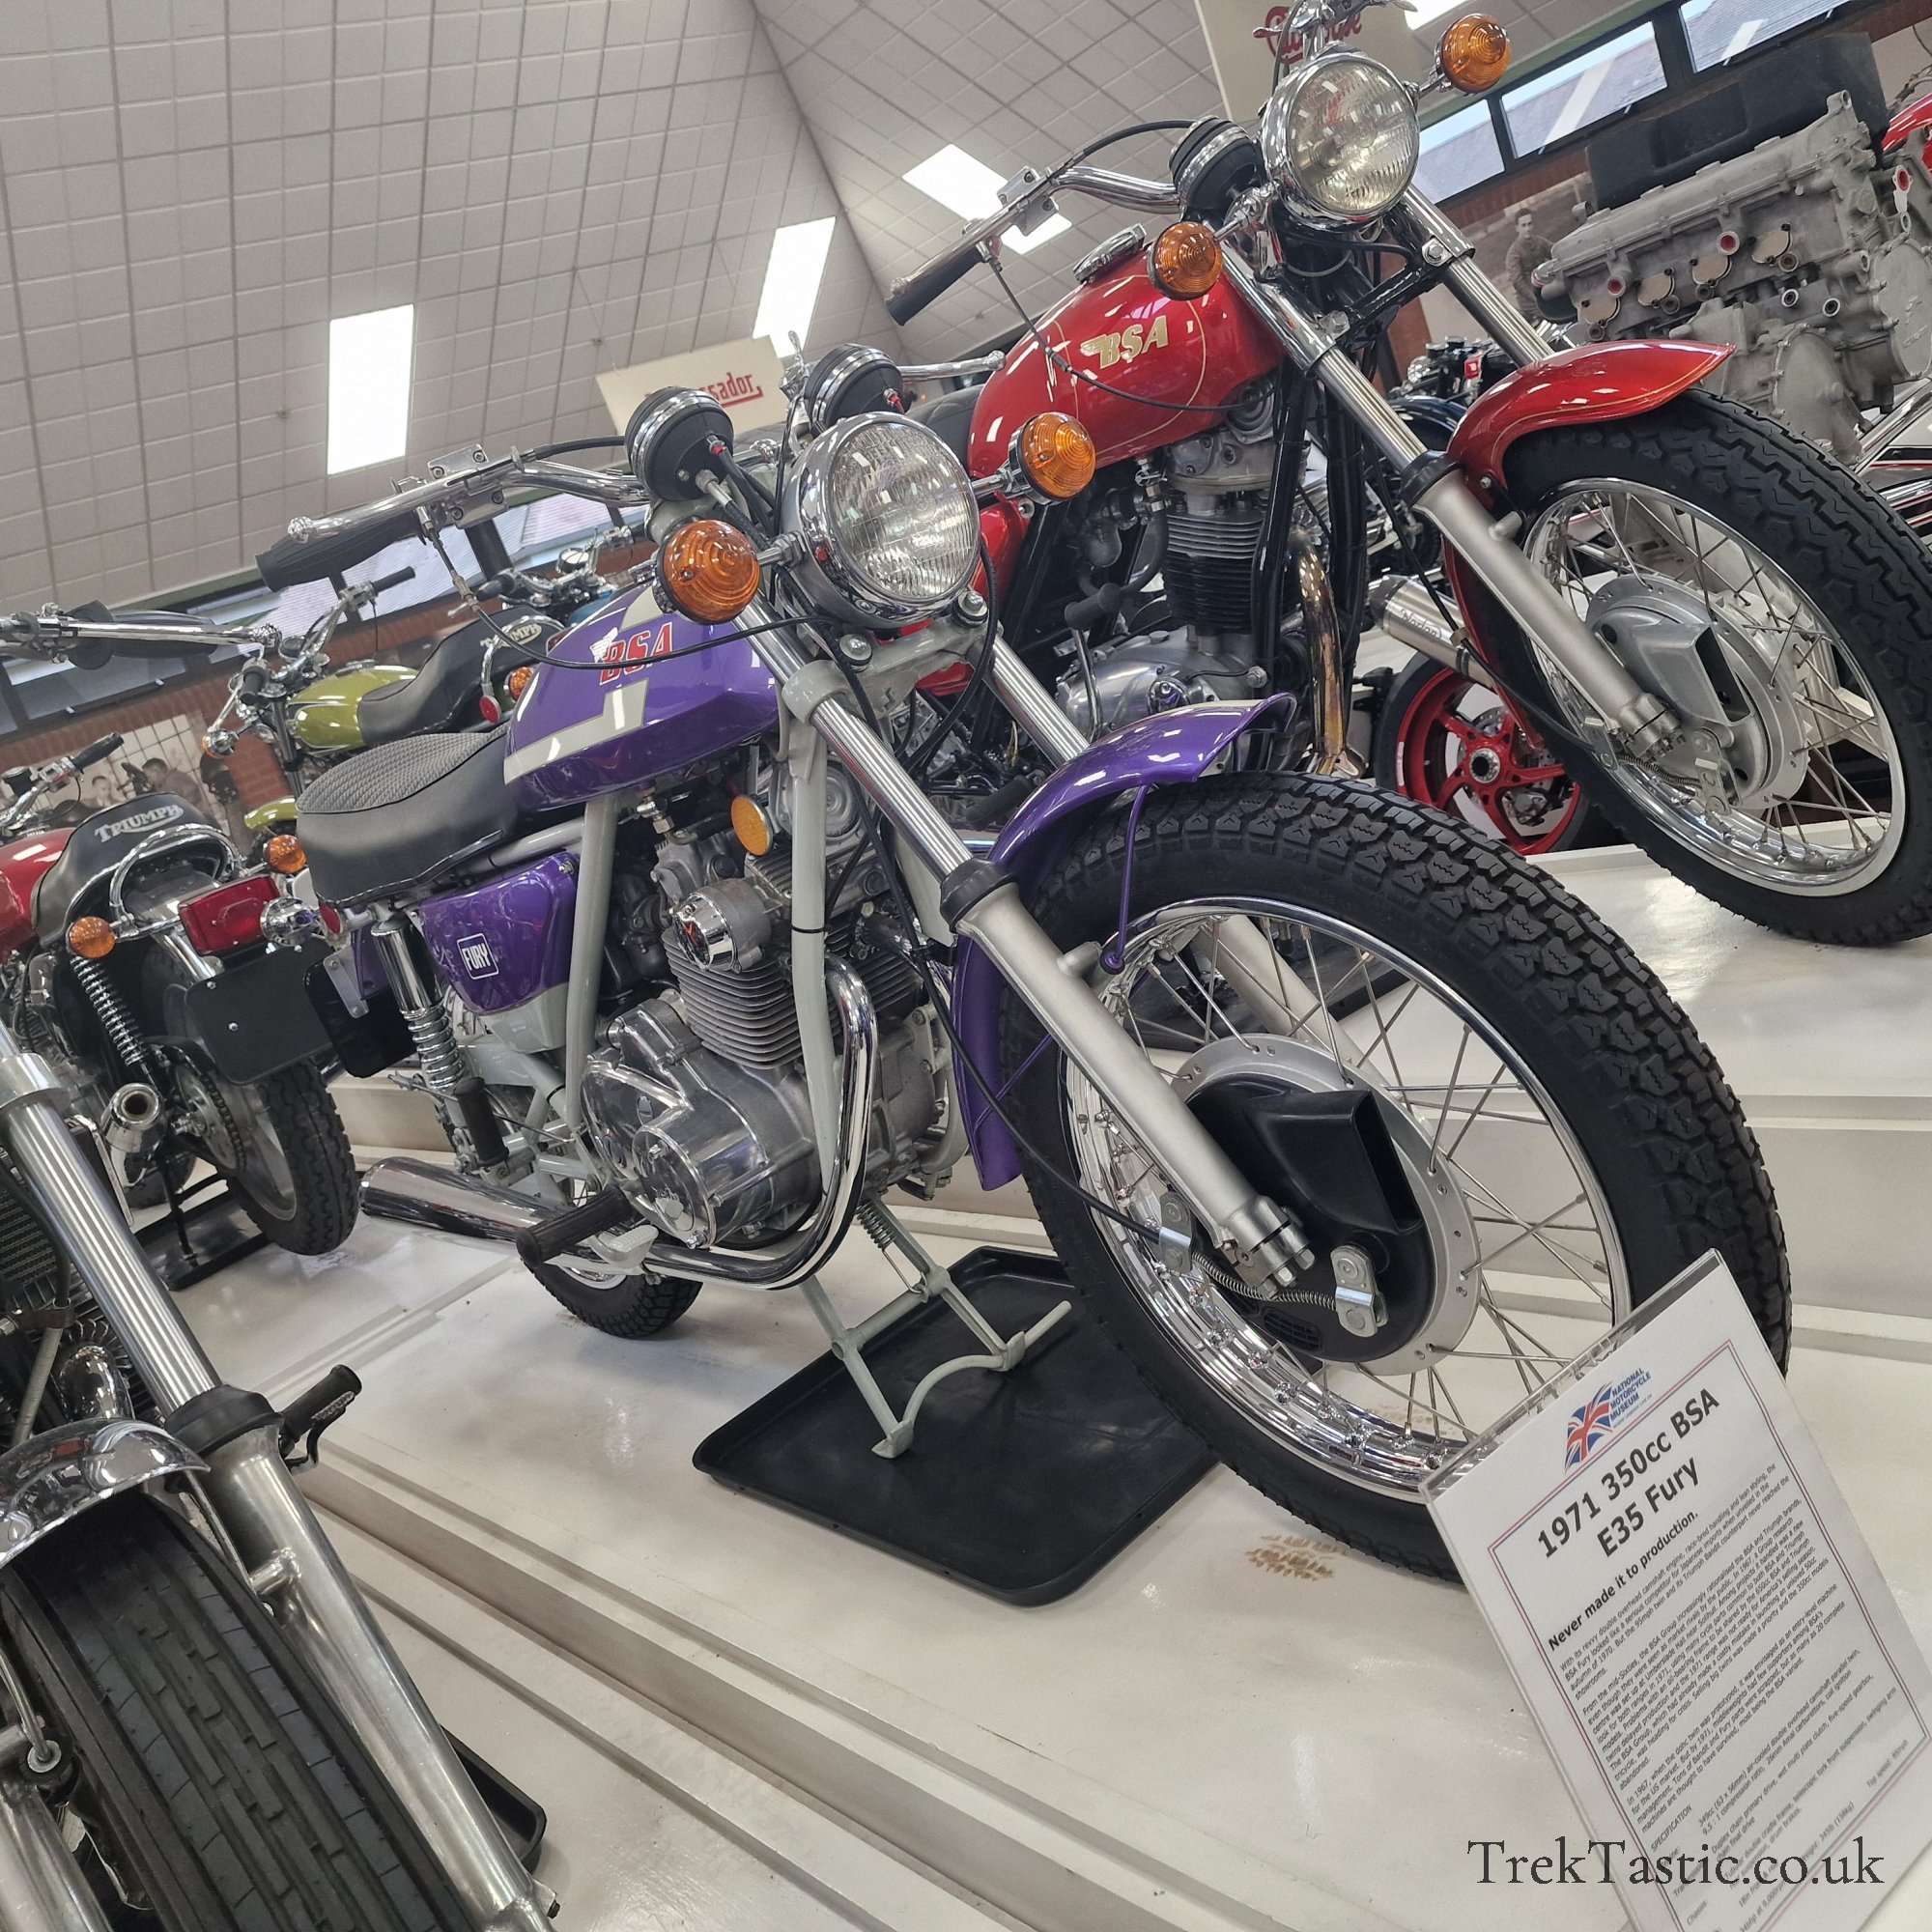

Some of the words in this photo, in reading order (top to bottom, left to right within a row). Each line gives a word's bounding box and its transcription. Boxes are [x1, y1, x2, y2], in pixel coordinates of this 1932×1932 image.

[1080, 315, 1168, 369] BSA
[590, 621, 673, 685] BSA
[94, 804, 185, 843] TRIUMPH
[462, 942, 491, 971] FURY
[1609, 1371, 1652, 1408] MOTORCYCLE
[1609, 1392, 1640, 1422] MUSEUM
[1611, 1367, 1645, 1398] NATIONAL
[1538, 1492, 1602, 1558] 1971
[1601, 1432, 1672, 1501] 350cc
[1670, 1388, 1720, 1439] BSA
[1597, 1502, 1644, 1557] E35
[1645, 1457, 1699, 1514] Fury
[1548, 1614, 1582, 1652] Never
[1584, 1585, 1616, 1620] made
[1615, 1575, 1627, 1589] it
[1626, 1564, 1639, 1579] to
[1639, 1511, 1699, 1571] production.
[1559, 1657, 1575, 1671] With
[1574, 1648, 1582, 1659] its
[1582, 1634, 1598, 1651] revvy
[1598, 1615, 1617, 1635] double
[1617, 1591, 1642, 1617] overhead
[1642, 1569, 1665, 1594] camshaft
[1708, 1508, 1730, 1530] handling
[1729, 1497, 1740, 1511] and
[1738, 1488, 1749, 1501] lean
[1766, 1463, 1776, 1474] the
[1564, 1666, 1577, 1682] BSA
[1577, 1654, 1591, 1669] Fury
[1590, 1635, 1609, 1657] looked
[1608, 1626, 1620, 1639] like
[1625, 1603, 1644, 1624] serious
[1670, 1568, 1679, 1579] for
[1680, 1547, 1703, 1572] Japanese
[1702, 1528, 1722, 1549] imports
[1722, 1515, 1735, 1530] when
[1735, 1494, 1755, 1518] unveiled
[1754, 1490, 1761, 1498] in
[1759, 1482, 1770, 1493] the
[1570, 1667, 1592, 1690] autumn
[1591, 1659, 1598, 1670] of
[1614, 1634, 1626, 1647] But
[1624, 1625, 1635, 1637] the
[1634, 1607, 1654, 1628] 95mph
[1653, 1596, 1665, 1609] twin
[1665, 1584, 1676, 1599] and
[1675, 1578, 1684, 1588] its
[1683, 1558, 1704, 1580] Triumph
[1703, 1542, 1720, 1560] Bandit
[1747, 1502, 1761, 1518] never
[1761, 1483, 1780, 1504] reached
[1779, 1475, 1789, 1487] the
[1582, 1698, 1598, 1716] From
[1597, 1689, 1608, 1701] the
[1638, 1647, 1649, 1660] the
[1648, 1635, 1661, 1650] BSA
[1660, 1620, 1677, 1638] Group
[1734, 1554, 1744, 1566] the
[1743, 1543, 1754, 1556] BSA
[1753, 1533, 1764, 1547] and
[1763, 1515, 1783, 1535] Triumph
[1587, 1709, 1602, 1725] even
[1601, 1690, 1621, 1711] though
[1620, 1677, 1634, 1691] they
[1634, 1662, 1647, 1679] were
[1647, 1649, 1661, 1665] seen
[1661, 1642, 1667, 1653] as
[1667, 1623, 1686, 1645] market
[1686, 1609, 1700, 1627] rivals
[1699, 1602, 1707, 1612] by
[1706, 1593, 1717, 1605] the
[1732, 1570, 1740, 1579] In
[1757, 1537, 1773, 1554] Group
[1773, 1517, 1793, 1539] research
[1592, 1714, 1610, 1734] centre
[1609, 1702, 1622, 1717] was
[1621, 1692, 1631, 1705] set
[1631, 1685, 1638, 1696] up
[1638, 1678, 1645, 1689] at
[1674, 1635, 1686, 1650] Hall
[1686, 1625, 1697, 1639] near
[1718, 1586, 1737, 1607] Among
[1736, 1567, 1755, 1591] projects
[1759, 1543, 1778, 1565] handled
[1778, 1534, 1789, 1546] was
[1793, 1520, 1804, 1532] new
[1596, 1729, 1609, 1744] look
[1608, 1719, 1617, 1731] for
[1617, 1707, 1631, 1722] both
[1631, 1688, 1649, 1709] ranges
[1648, 1682, 1656, 1690] in
[1670, 1651, 1686, 1668] using
[1685, 1636, 1699, 1654] many
[1699, 1623, 1714, 1639] cycle
[1713, 1608, 1726, 1627] parts
[1726, 1588, 1747, 1611] common
[1747, 1581, 1753, 1591] to
[1752, 1570, 1765, 1585] both
[1764, 1559, 1776, 1573] BSA
[1776, 1549, 1785, 1563] and
[1784, 1530, 1804, 1552] Triumph
[1651, 1804, 1691, 1852] SPECIFICATION
